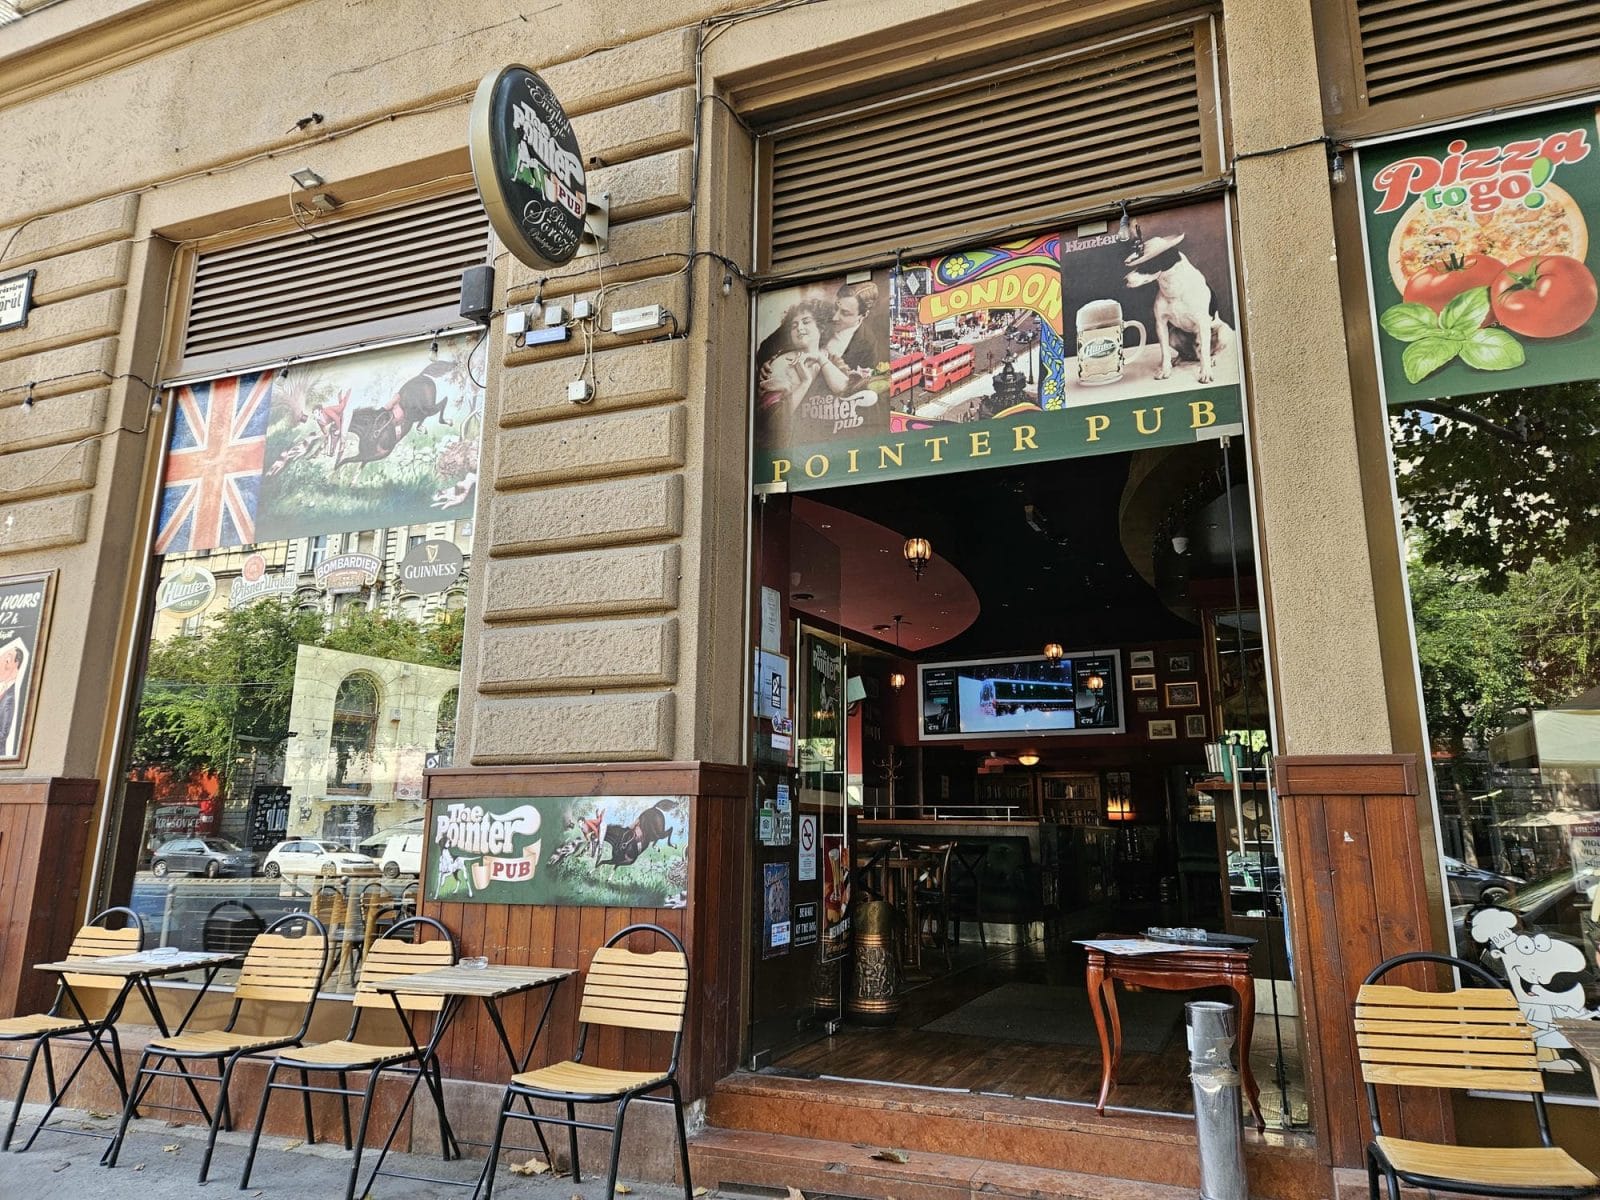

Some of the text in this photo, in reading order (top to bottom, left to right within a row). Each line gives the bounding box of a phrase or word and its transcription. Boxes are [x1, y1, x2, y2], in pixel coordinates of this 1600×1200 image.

[521, 100, 551, 141] The
[512, 103, 585, 189] Pointer
[1373, 128, 1591, 214] Pizza
[1423, 157, 1556, 213] to go!
[558, 185, 581, 215] PUB
[1065, 233, 1120, 253] Hunter
[930, 272, 1063, 320] LONDON
[801, 390, 879, 420] Pointer
[809, 394, 834, 406] The
[833, 416, 864, 434] pub
[772, 400, 1217, 483] POINTER PUB
[317, 556, 378, 578] BOMBARDIER
[404, 562, 457, 579] GUINNESS
[1, 592, 41, 610] HOURS
[163, 580, 210, 603] Hunter
[448, 803, 484, 823] The
[435, 805, 541, 855] Pointer
[492, 861, 531, 879] PUB
